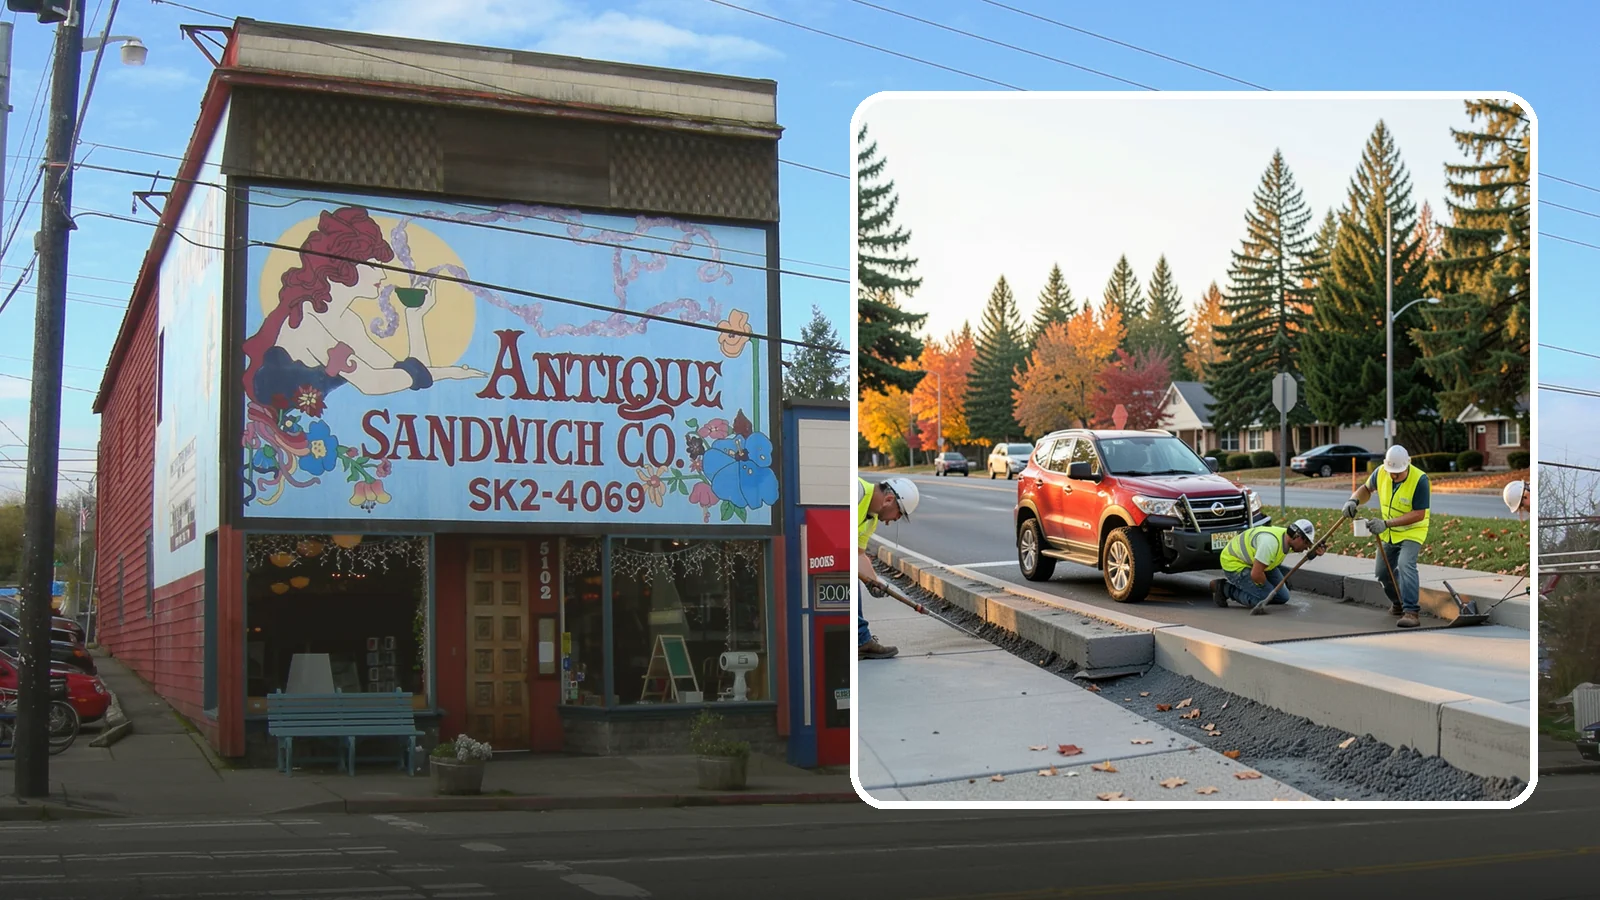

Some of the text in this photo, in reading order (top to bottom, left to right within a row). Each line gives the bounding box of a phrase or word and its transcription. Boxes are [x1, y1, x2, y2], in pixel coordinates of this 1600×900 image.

[476, 328, 723, 421] ANTIQUE
[361, 408, 685, 469] SANDWICH CO.
[468, 477, 646, 512] SK2-4069
[540, 541, 552, 600] 5102
[809, 555, 834, 569] BOOKS
